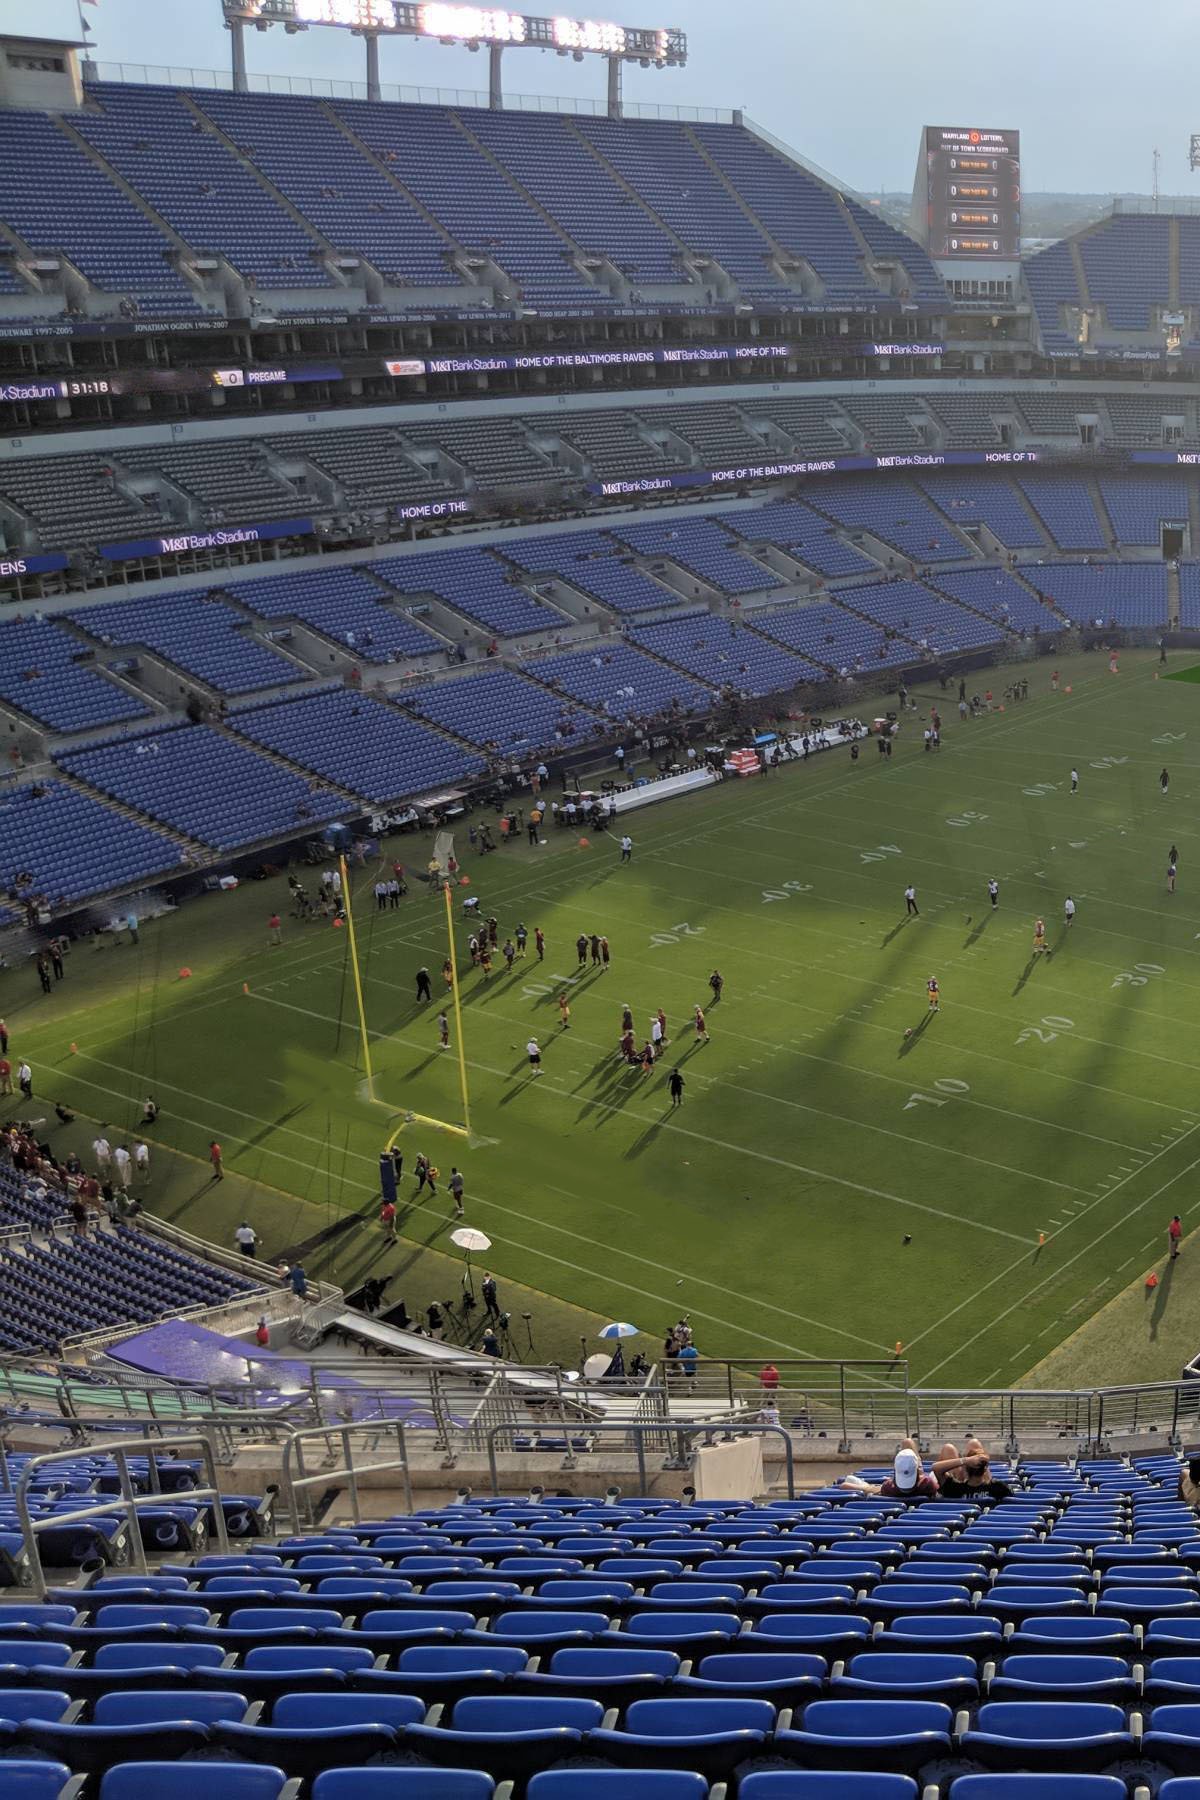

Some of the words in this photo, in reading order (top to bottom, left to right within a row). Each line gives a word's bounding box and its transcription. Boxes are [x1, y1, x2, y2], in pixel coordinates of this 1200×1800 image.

[942, 132, 970, 140] MARYLAND
[134, 323, 170, 332] JONATHAN
[170, 322, 194, 331] OGDEN
[663, 351, 681, 361] M&T
[681, 351, 700, 361] Bank
[700, 349, 728, 360] Stadium
[736, 347, 758, 357] HOME
[759, 347, 769, 356] OF
[770, 346, 787, 355] THE
[874, 345, 894, 355] M&T
[893, 345, 912, 354] Bank
[912, 344, 942, 354] Stadium
[431, 360, 453, 372] M&T
[453, 360, 474, 371] Bank
[474, 359, 507, 370] Stadium
[515, 358, 541, 367] HOME
[543, 356, 555, 366] OF
[558, 356, 573, 365] THE
[574, 353, 620, 365] BALTIMORE
[622, 352, 654, 362] RAVENS
[229, 373, 237, 384] 0
[249, 371, 287, 382] PREGAME
[8, 386, 55, 400] Stadium
[72, 382, 109, 394] 31:18
[877, 457, 895, 467] M&T
[895, 456, 914, 466] Bank
[914, 455, 944, 465] Stadium
[985, 453, 1011, 462] HOME
[1013, 452, 1025, 461] OF
[1177, 454, 1198, 464] M&T
[712, 471, 735, 481] HOME
[736, 469, 747, 479] OF
[749, 468, 764, 477] THE
[765, 464, 806, 475] BALTIMORE
[807, 460, 836, 471] RAVENS
[601, 483, 622, 495] M&T
[622, 481, 641, 492] Bank
[641, 478, 671, 490] Stadium
[401, 507, 430, 518] HOME
[432, 504, 446, 515] OF
[448, 501, 467, 512] THE
[162, 538, 190, 553] M&T
[190, 534, 216, 549] Bank
[216, 528, 259, 545] Stadium
[946, 811, 990, 827] 50
[860, 844, 902, 862] 40
[762, 880, 813, 900] 30
[650, 922, 707, 945] 20
[1116, 963, 1165, 986] 30
[522, 974, 580, 996] 10
[1020, 1016, 1075, 1044] 20
[908, 1078, 970, 1108] 10
